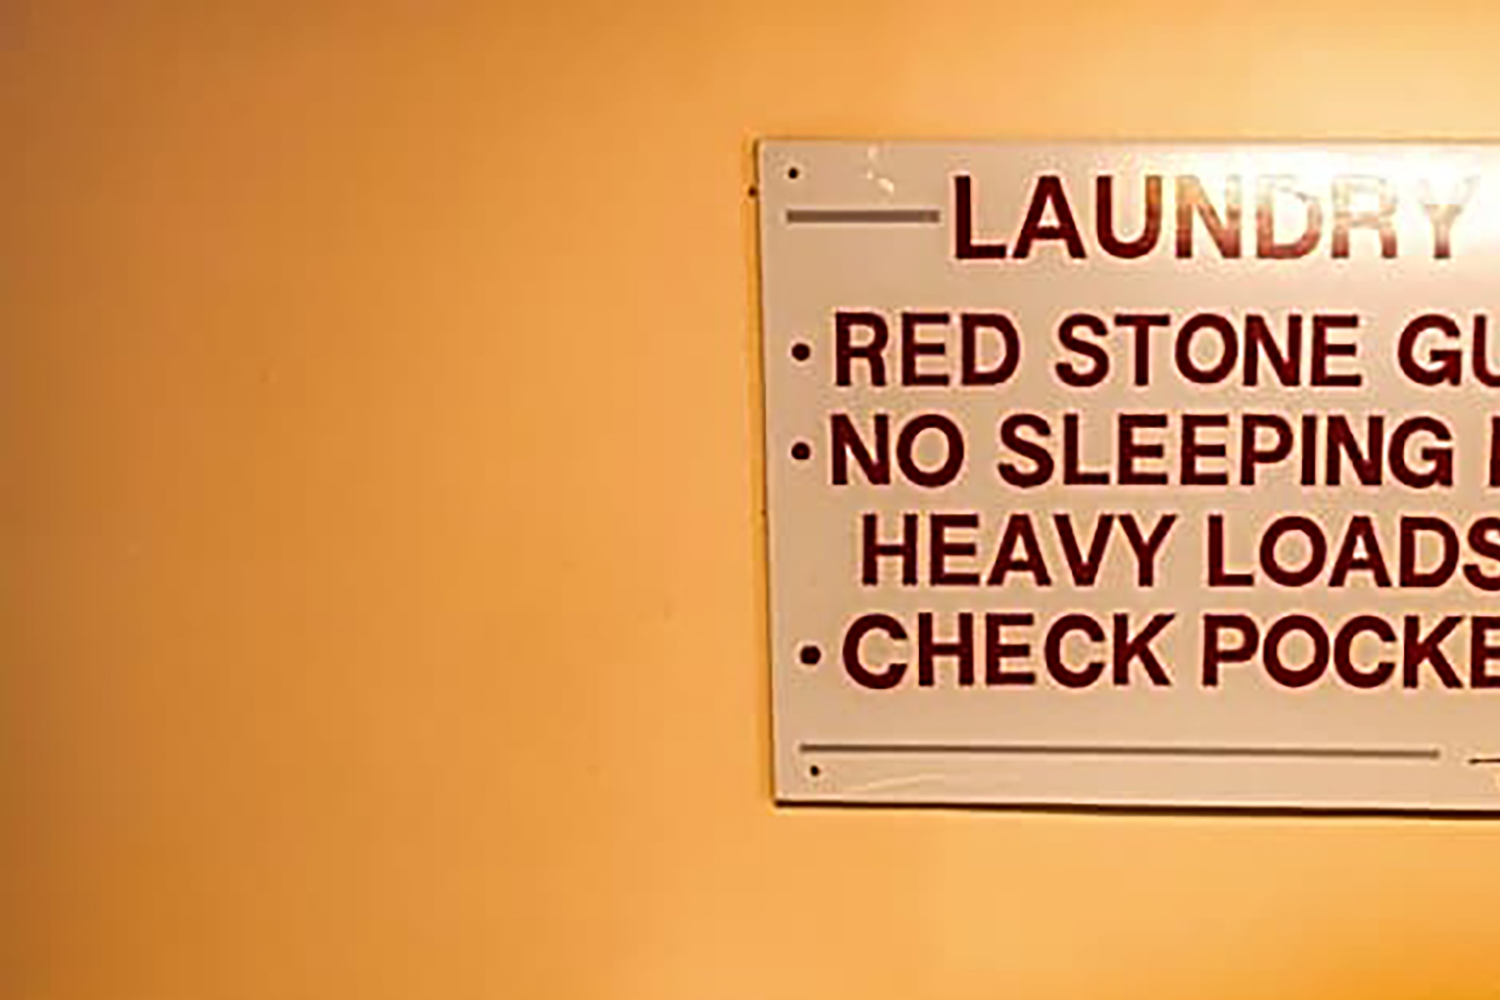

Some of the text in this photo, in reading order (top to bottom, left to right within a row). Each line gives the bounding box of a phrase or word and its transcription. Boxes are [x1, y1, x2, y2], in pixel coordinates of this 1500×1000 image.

[953, 174, 1474, 261] LAUNDRY
[833, 310, 1021, 388] RED
[1053, 312, 1364, 389] STONE
[828, 412, 966, 490] NO
[996, 412, 1455, 490] SLEEPING
[860, 511, 1179, 589] HEAVY
[840, 610, 1177, 691] CHECK
